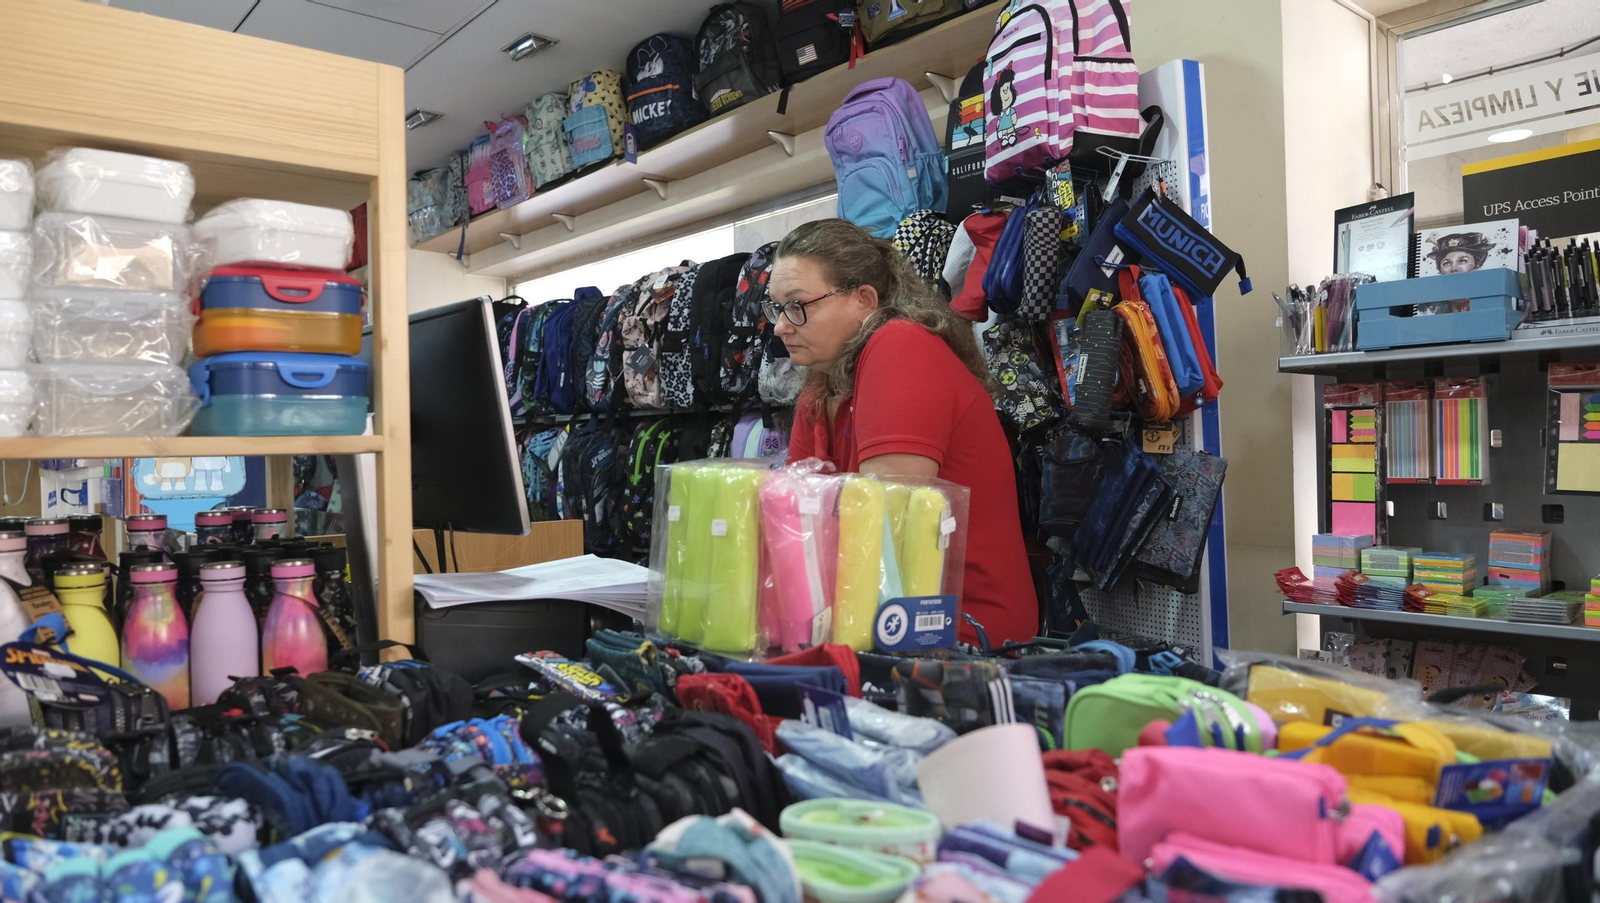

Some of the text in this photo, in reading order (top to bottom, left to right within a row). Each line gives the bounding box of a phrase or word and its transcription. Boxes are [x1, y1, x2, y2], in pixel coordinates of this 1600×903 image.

[632, 99, 671, 125] MICKEY
[1483, 187, 1600, 217] UPS Access Point
[1138, 203, 1226, 276] MUNICH
